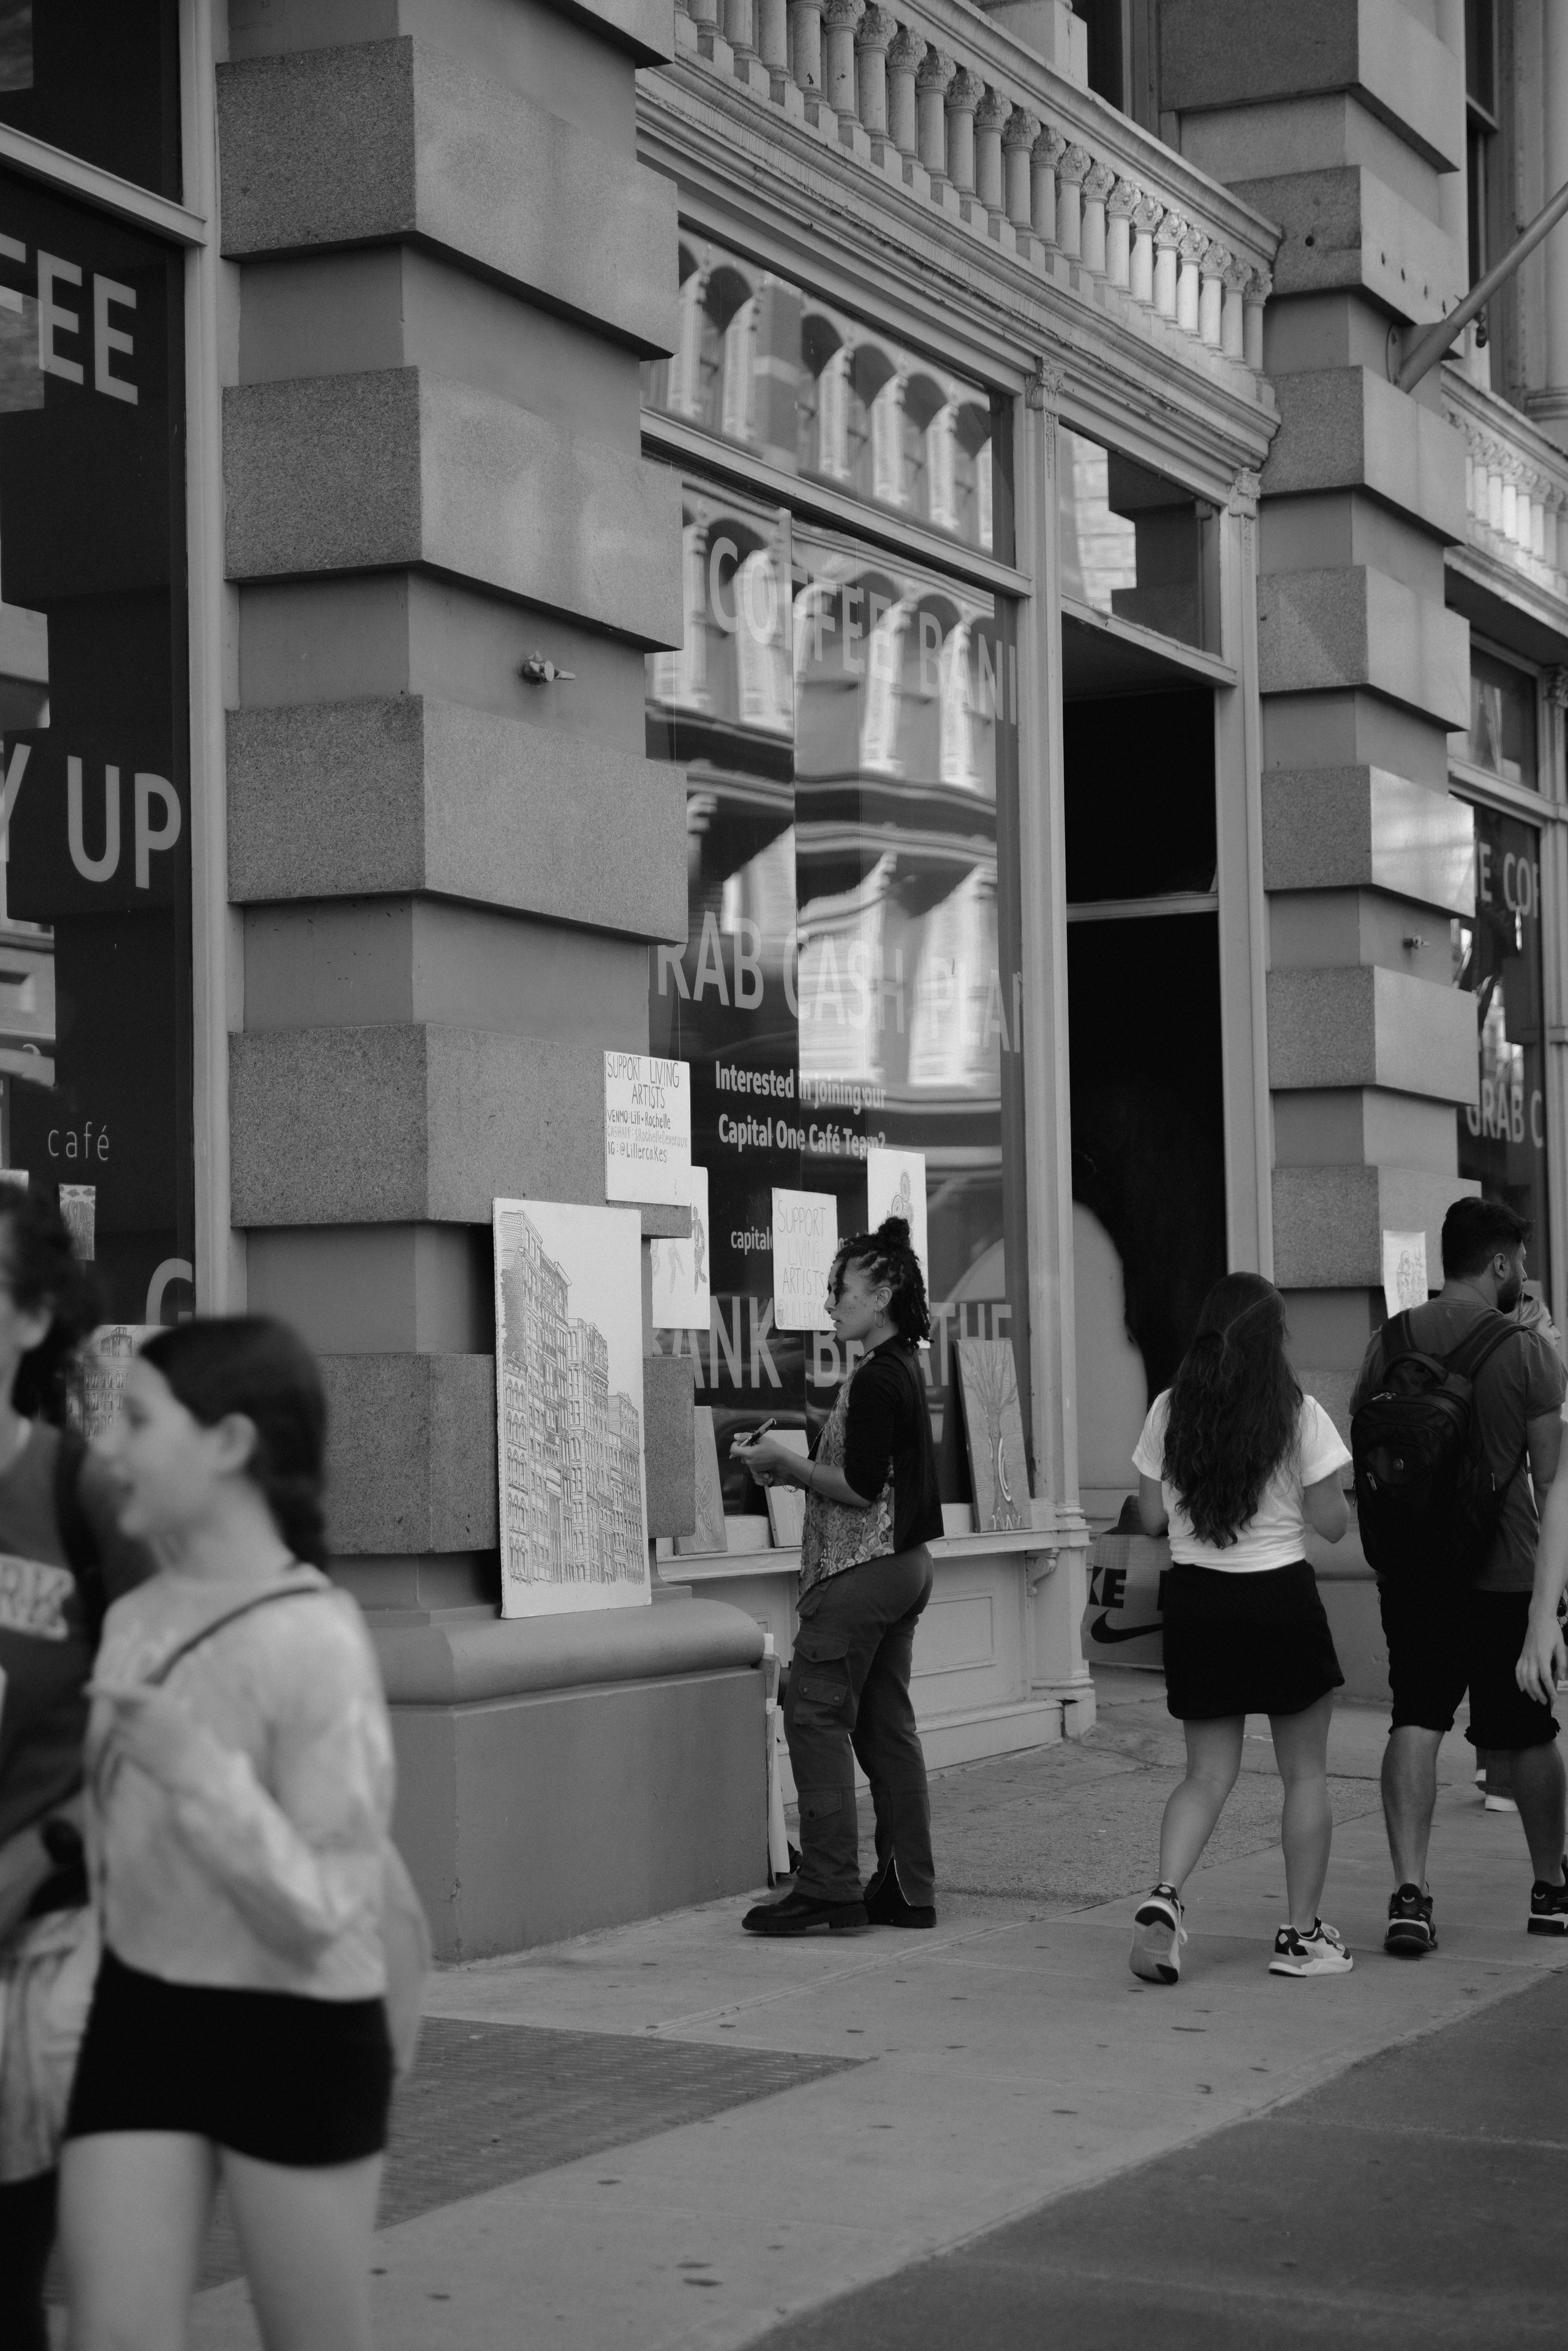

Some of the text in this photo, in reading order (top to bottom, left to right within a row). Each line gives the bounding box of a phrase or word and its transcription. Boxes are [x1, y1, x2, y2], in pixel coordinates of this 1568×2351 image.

[709, 537, 892, 683] COFFEE
[67, 755, 181, 889] UP
[783, 927, 904, 1034] CASH
[607, 1053, 679, 1088] SUPPORT LIVING
[715, 1060, 886, 1115] Interested in joining our
[631, 1084, 665, 1109] ARTISTS
[48, 1121, 110, 1161] café
[718, 1114, 772, 1152] Capital
[776, 1120, 805, 1150] One
[809, 1123, 840, 1154] Café
[777, 1199, 826, 1237] SUPPORT
[787, 1239, 820, 1267] LIVING
[782, 1267, 826, 1298] ARTISTS
